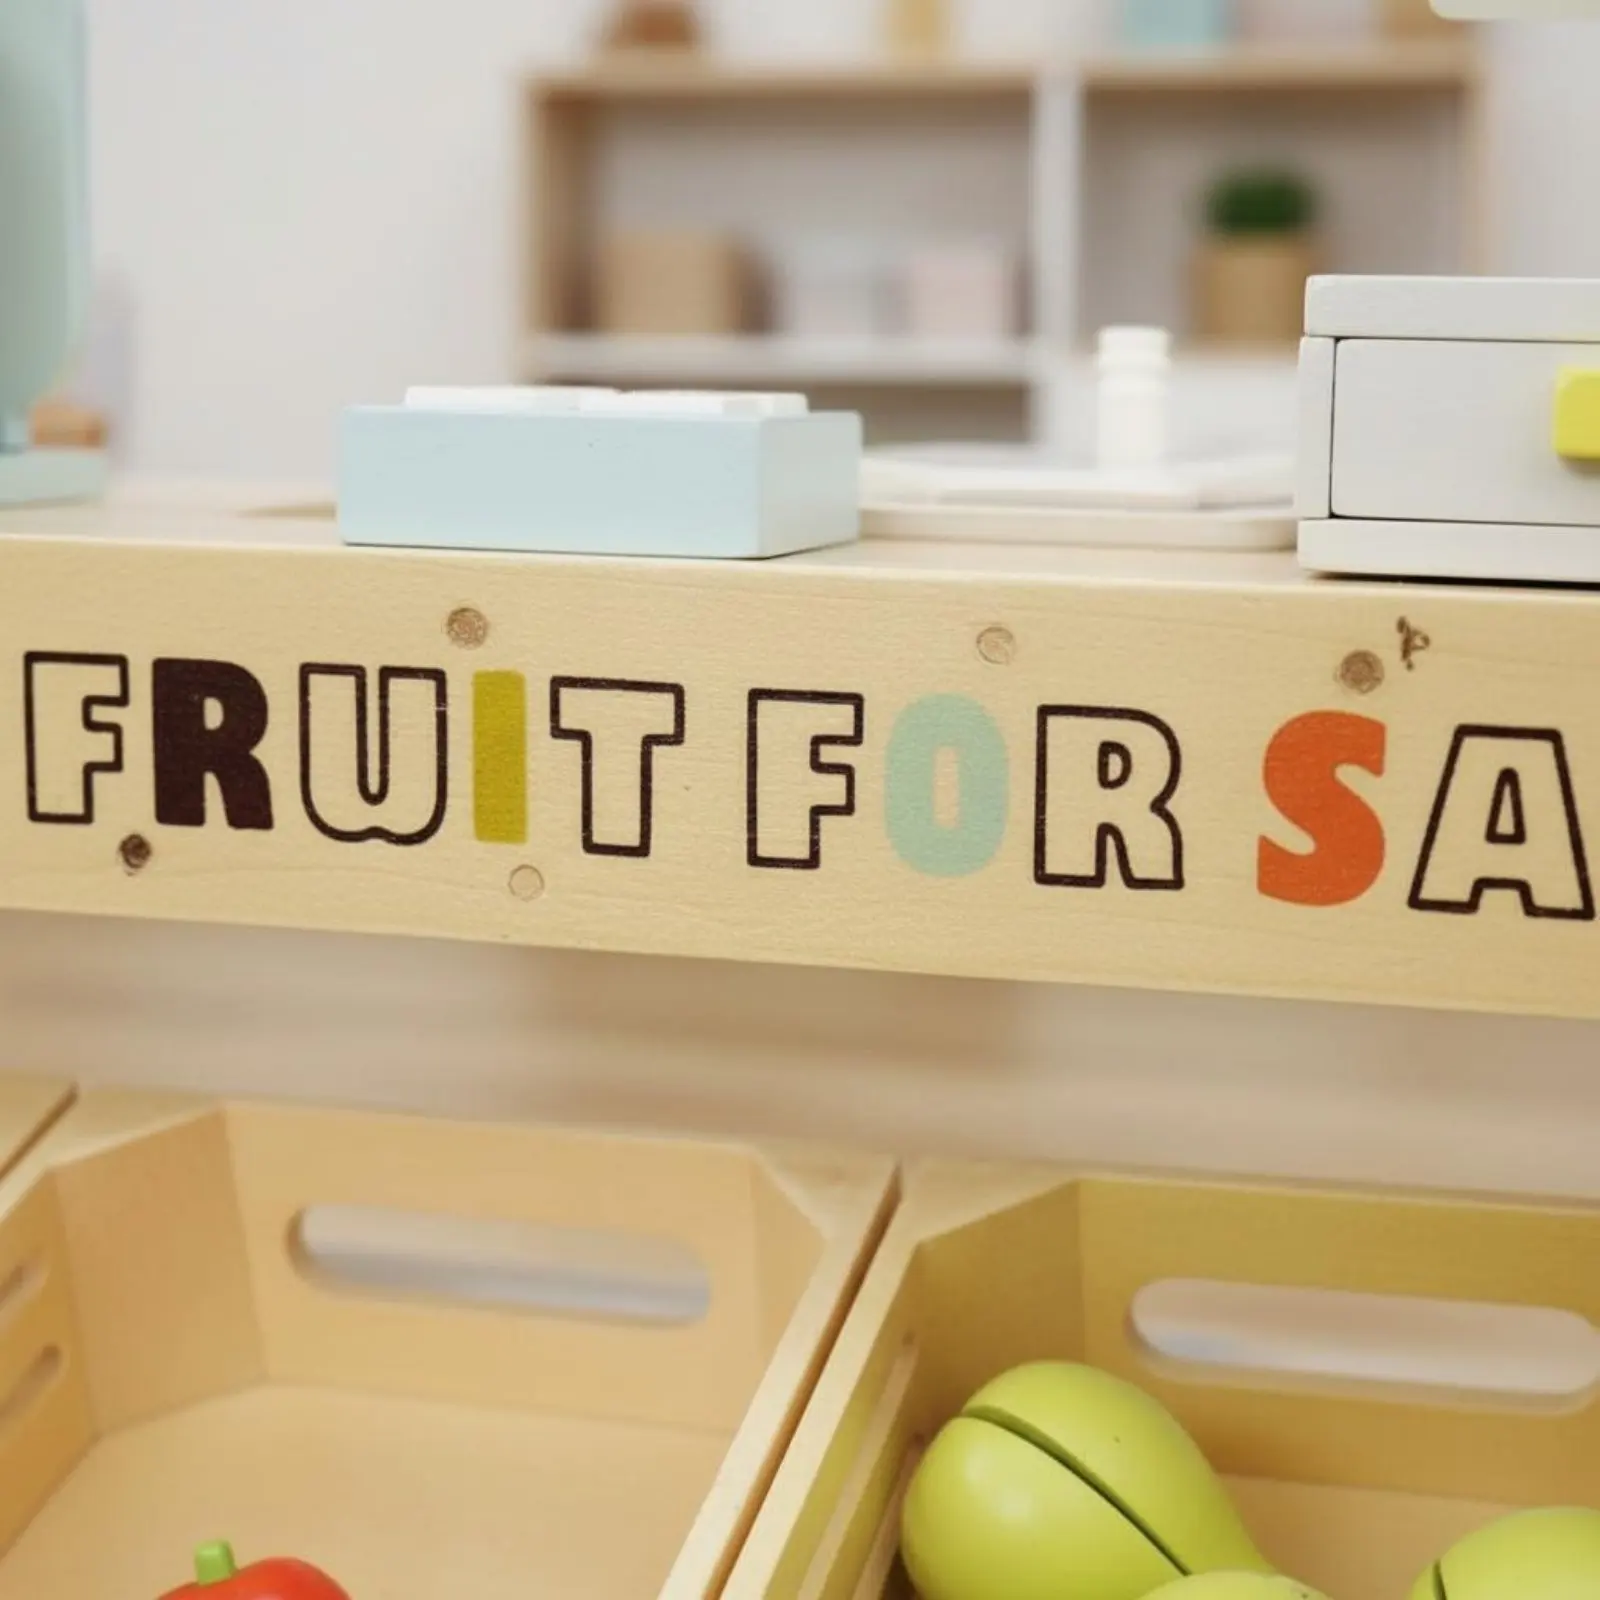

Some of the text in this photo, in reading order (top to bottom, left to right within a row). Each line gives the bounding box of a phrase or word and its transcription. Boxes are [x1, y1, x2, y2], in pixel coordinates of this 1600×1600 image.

[23, 651, 1595, 922] FRUIT FOR SA
